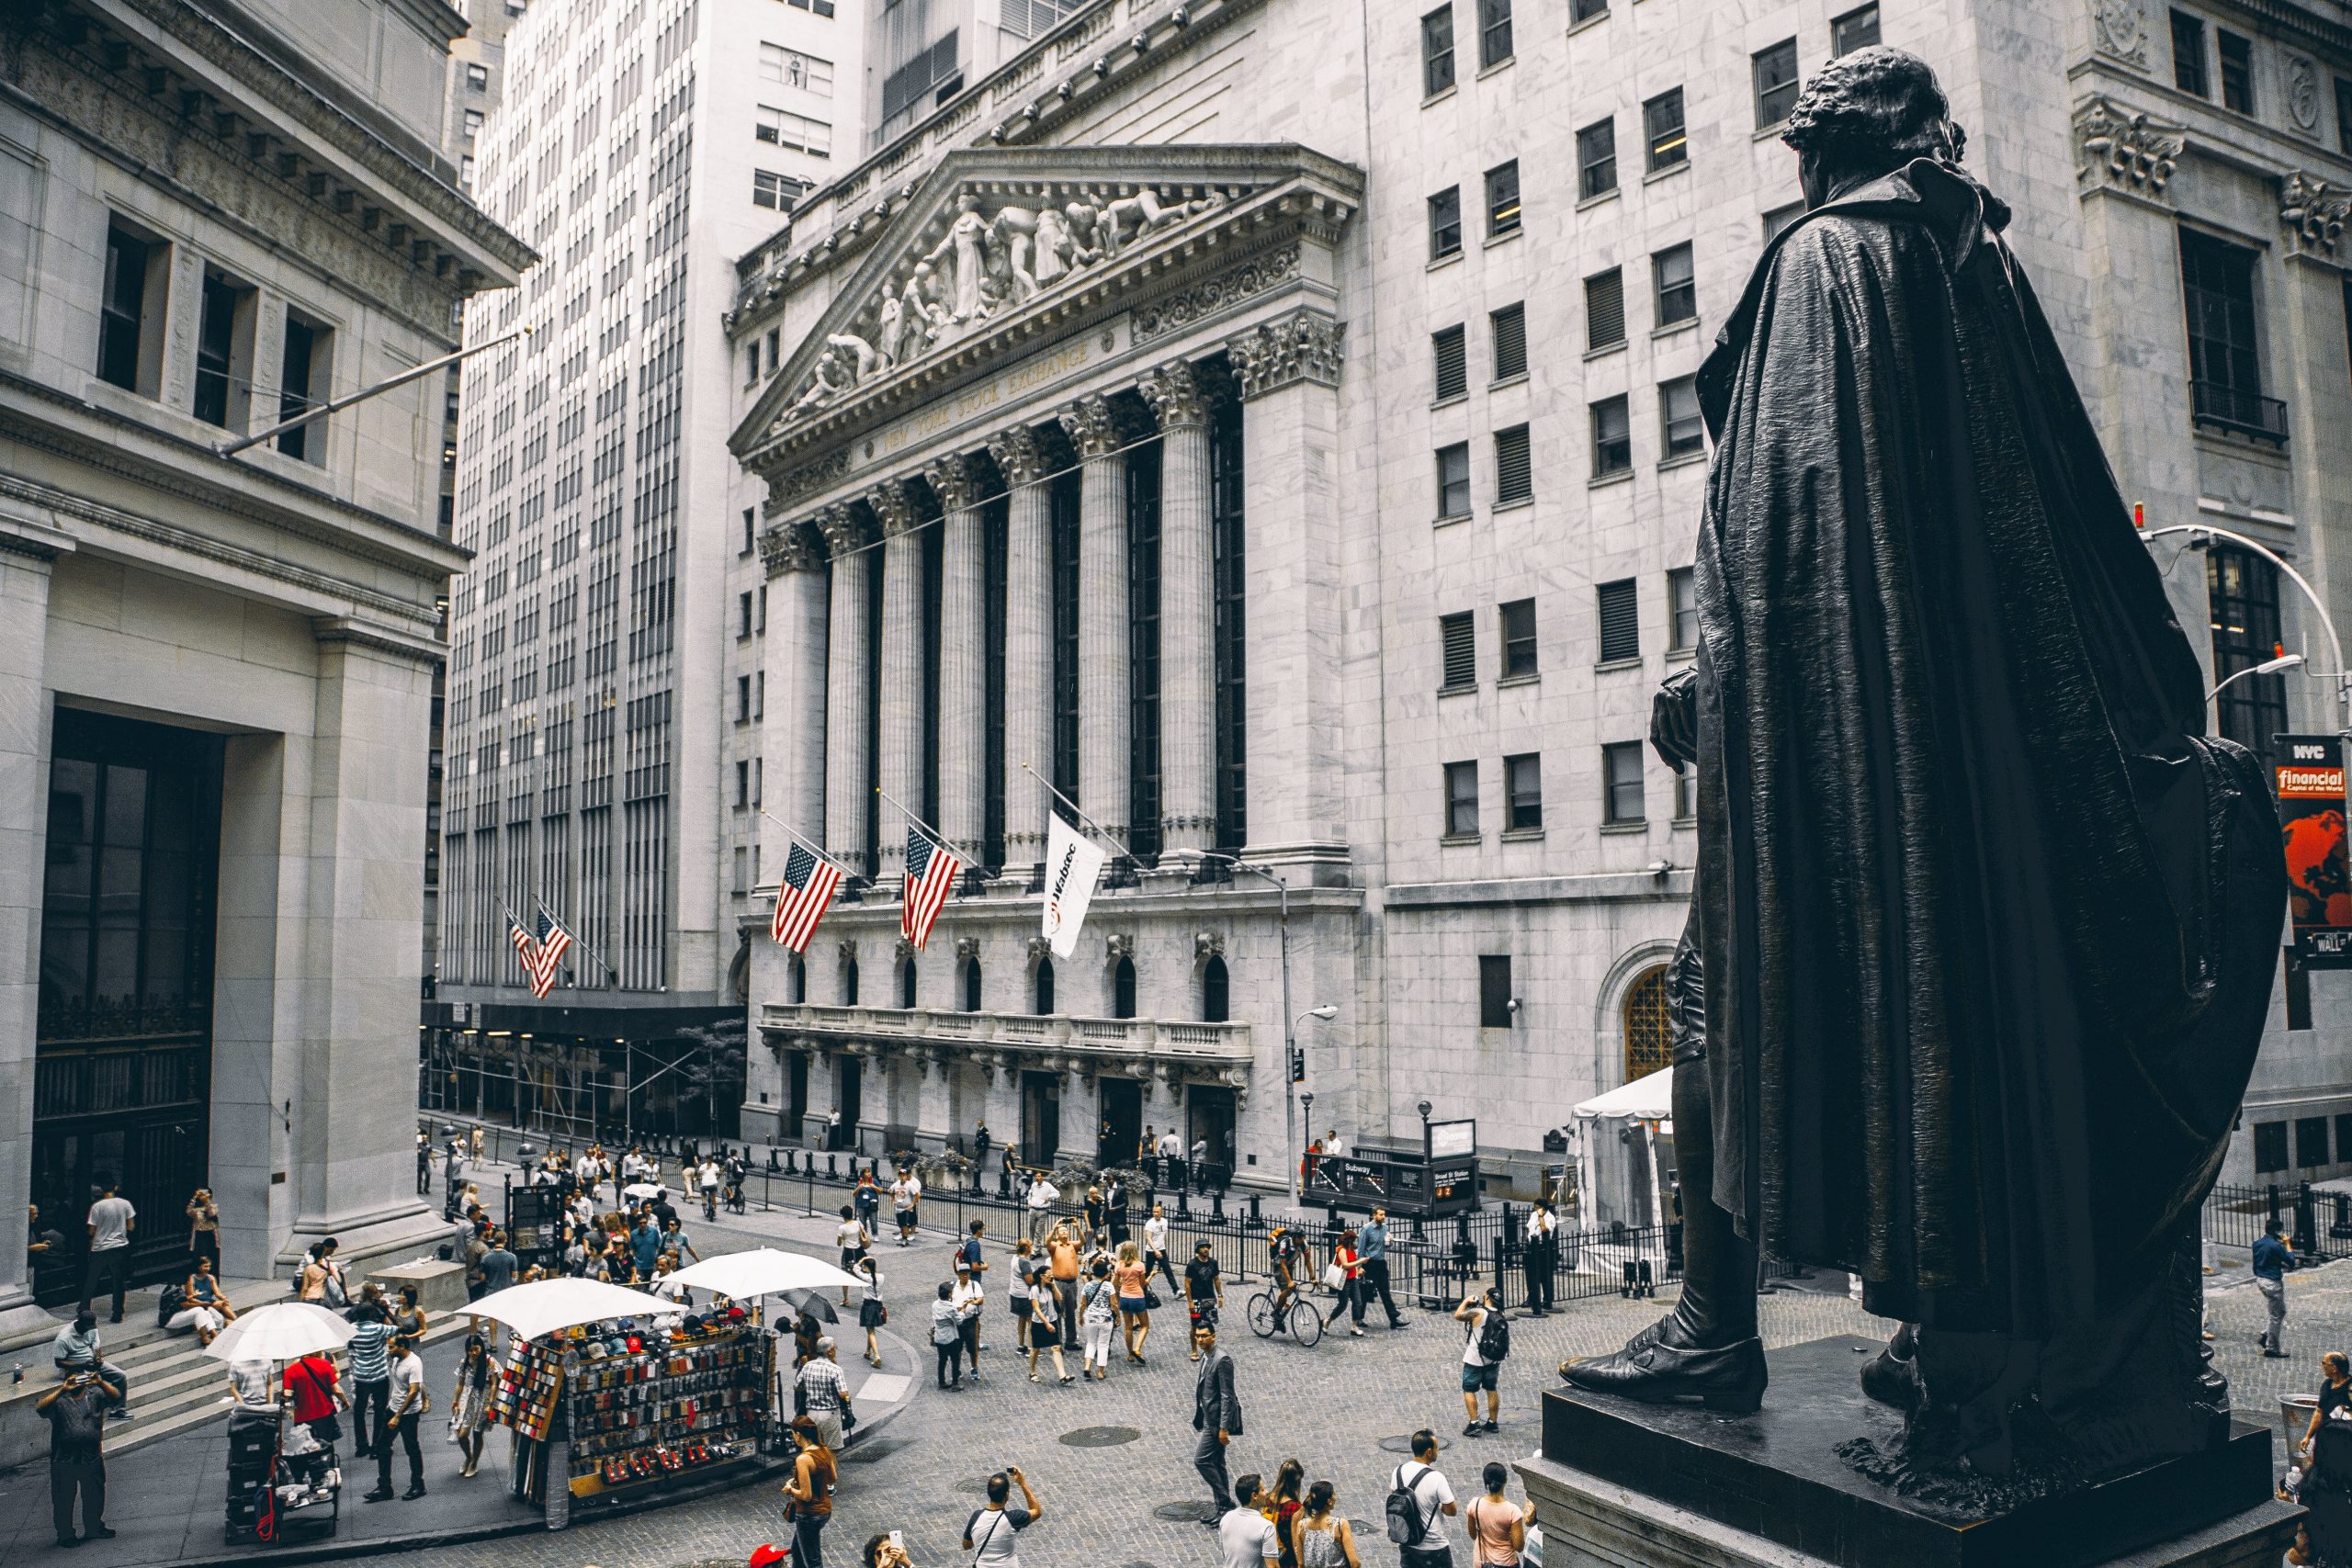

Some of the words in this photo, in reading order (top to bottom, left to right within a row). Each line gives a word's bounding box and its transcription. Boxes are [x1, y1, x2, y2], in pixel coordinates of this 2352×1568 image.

[884, 425, 910, 451] NEW
[917, 407, 950, 435] YORK
[957, 381, 1000, 417] STOCK
[1008, 343, 1088, 394] EXCHANGE
[2293, 745, 2324, 760] NYC
[2278, 770, 2343, 789] financial
[2317, 939, 2341, 952] WALL
[1345, 1163, 1371, 1175] Subway
